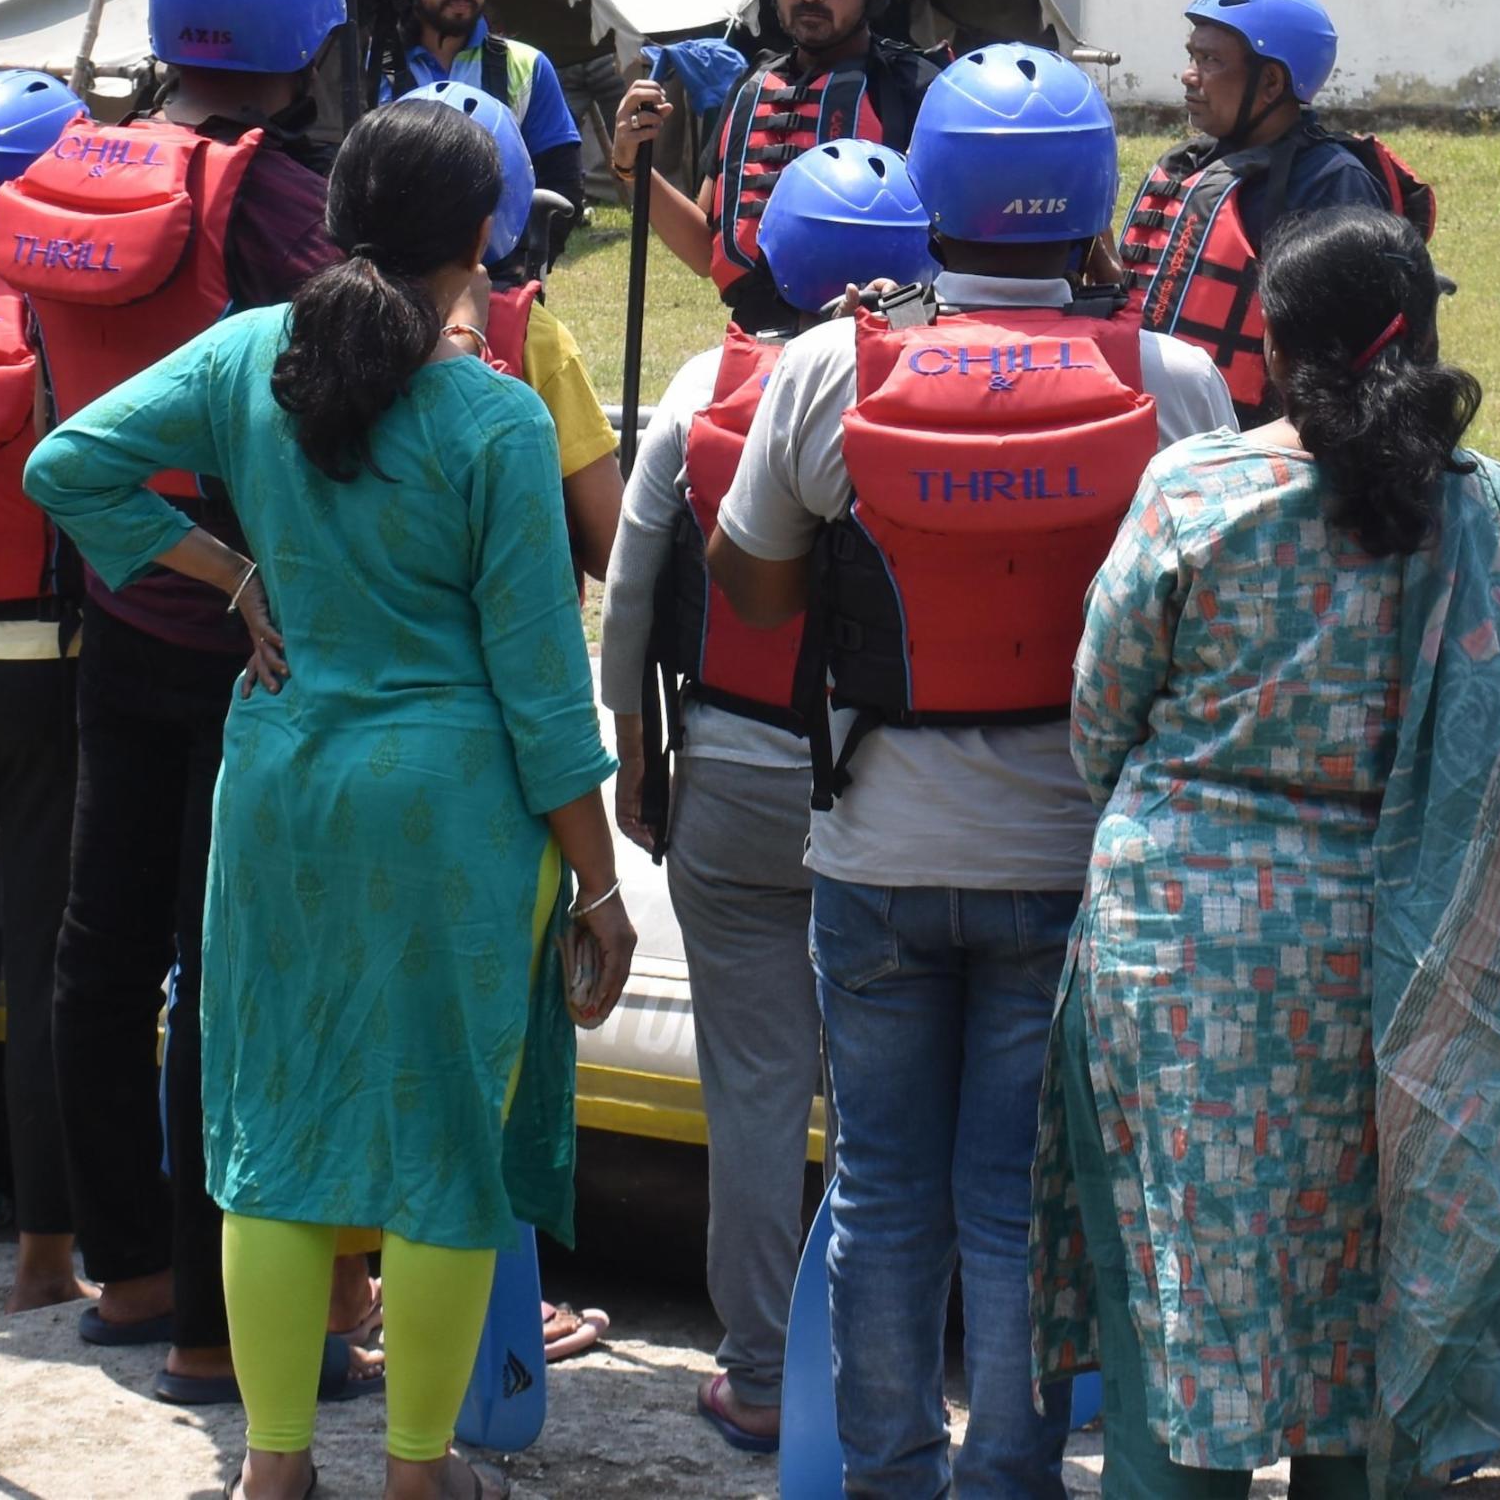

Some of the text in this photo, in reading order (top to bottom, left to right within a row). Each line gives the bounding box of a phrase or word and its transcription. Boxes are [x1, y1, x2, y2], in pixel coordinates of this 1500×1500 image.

[179, 27, 233, 45] AXIS
[54, 134, 165, 166] CHILL
[88, 164, 105, 178] &
[1001, 197, 1069, 215] AXIS
[13, 233, 122, 272] THRILL
[908, 342, 1095, 376] CHILL
[988, 373, 1014, 391] &
[907, 463, 1097, 503] THRILL
